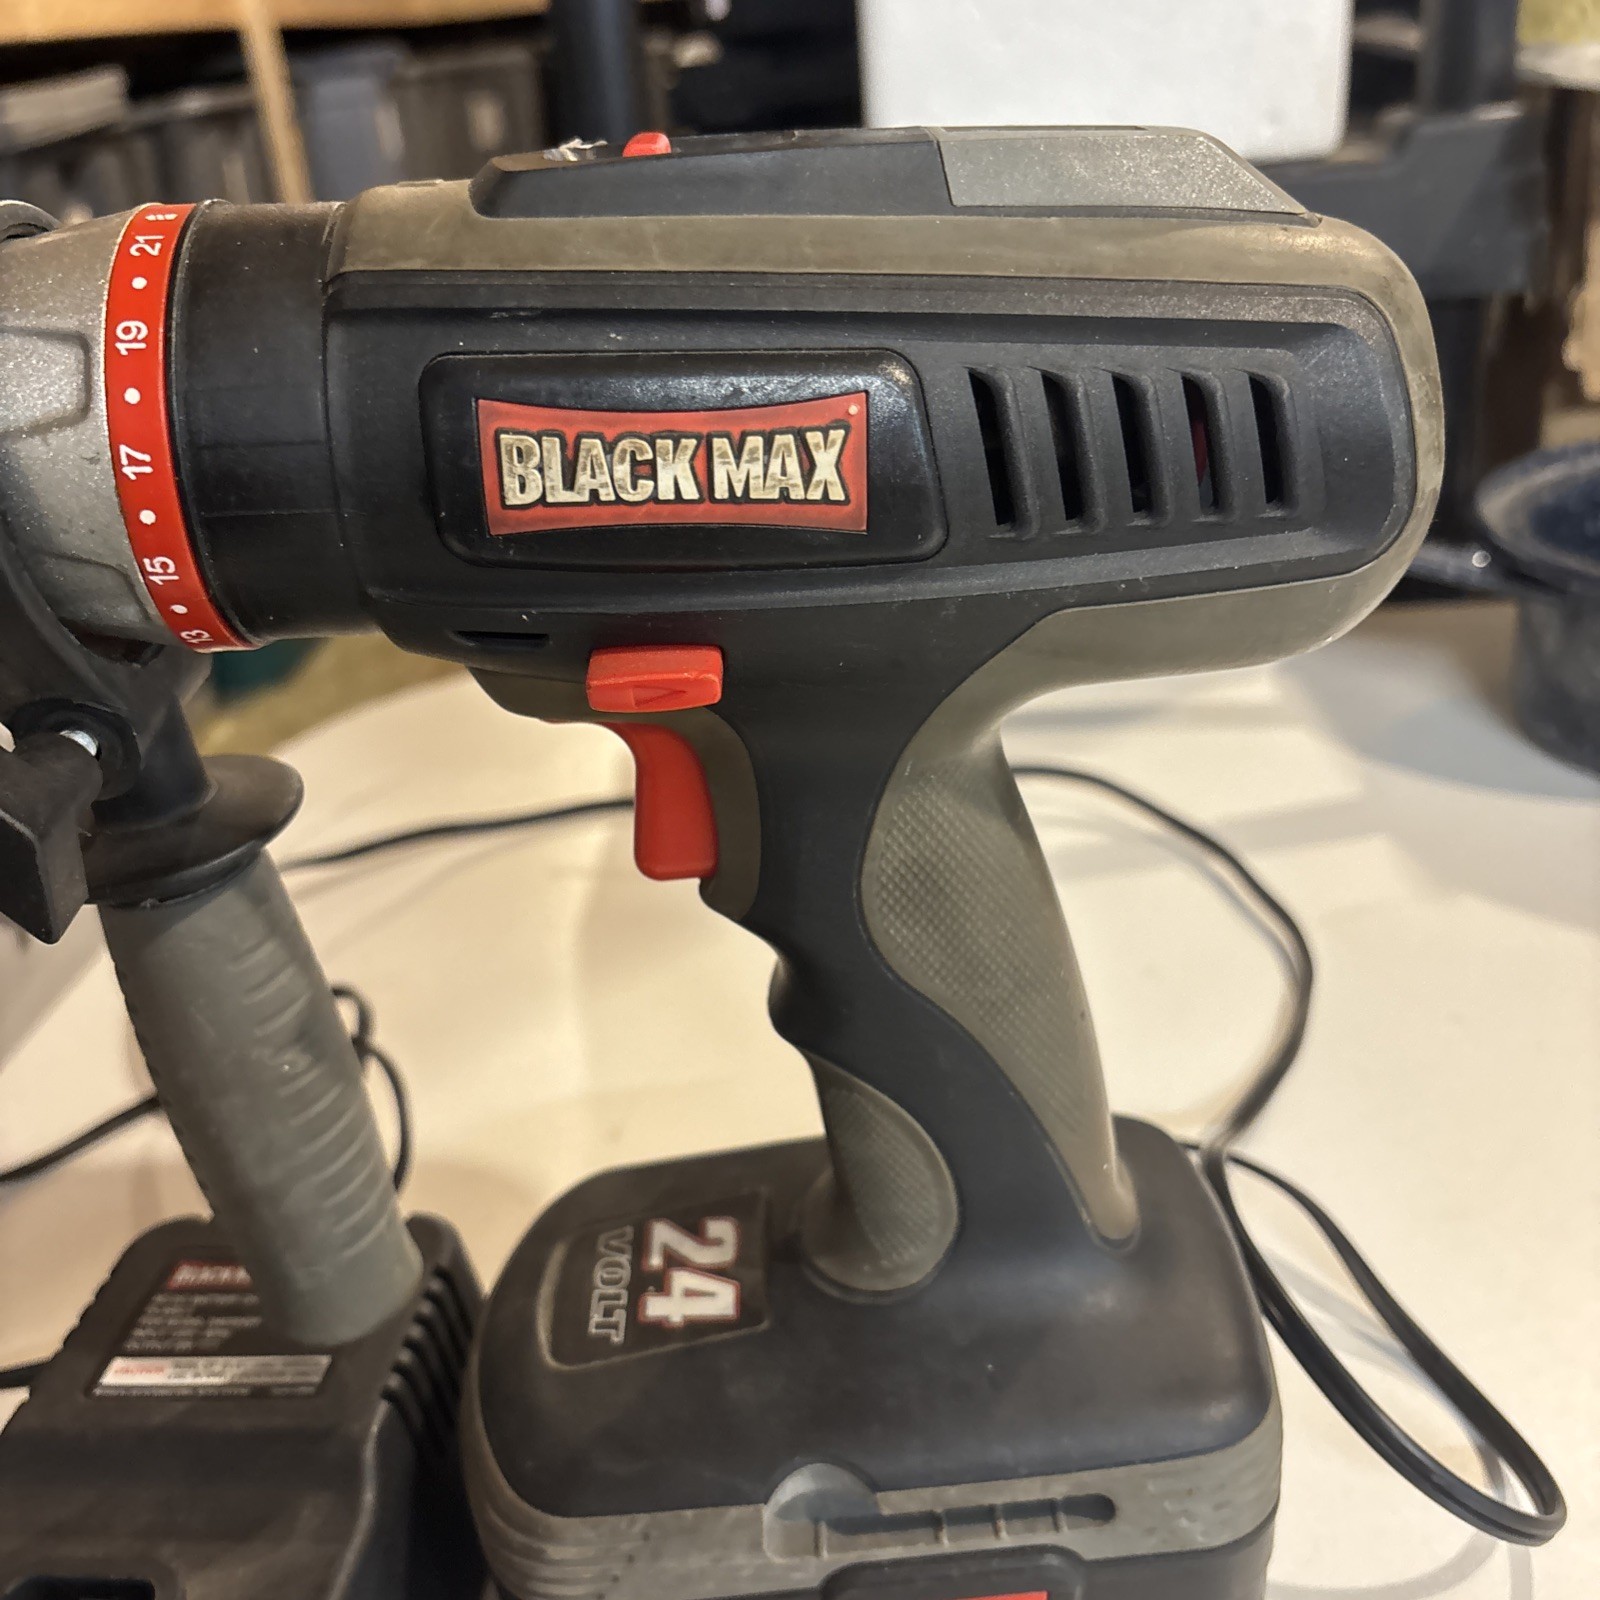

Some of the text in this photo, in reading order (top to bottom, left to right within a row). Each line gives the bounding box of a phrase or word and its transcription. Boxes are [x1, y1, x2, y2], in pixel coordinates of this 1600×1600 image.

[129, 234, 165, 257] 21
[114, 320, 149, 356] 19
[118, 443, 154, 481] 17
[497, 426, 847, 506] BLACK MAX
[142, 555, 180, 586] 15
[179, 628, 215, 645] 13
[587, 1224, 636, 1346] VOLT
[637, 1215, 742, 1329] 24
